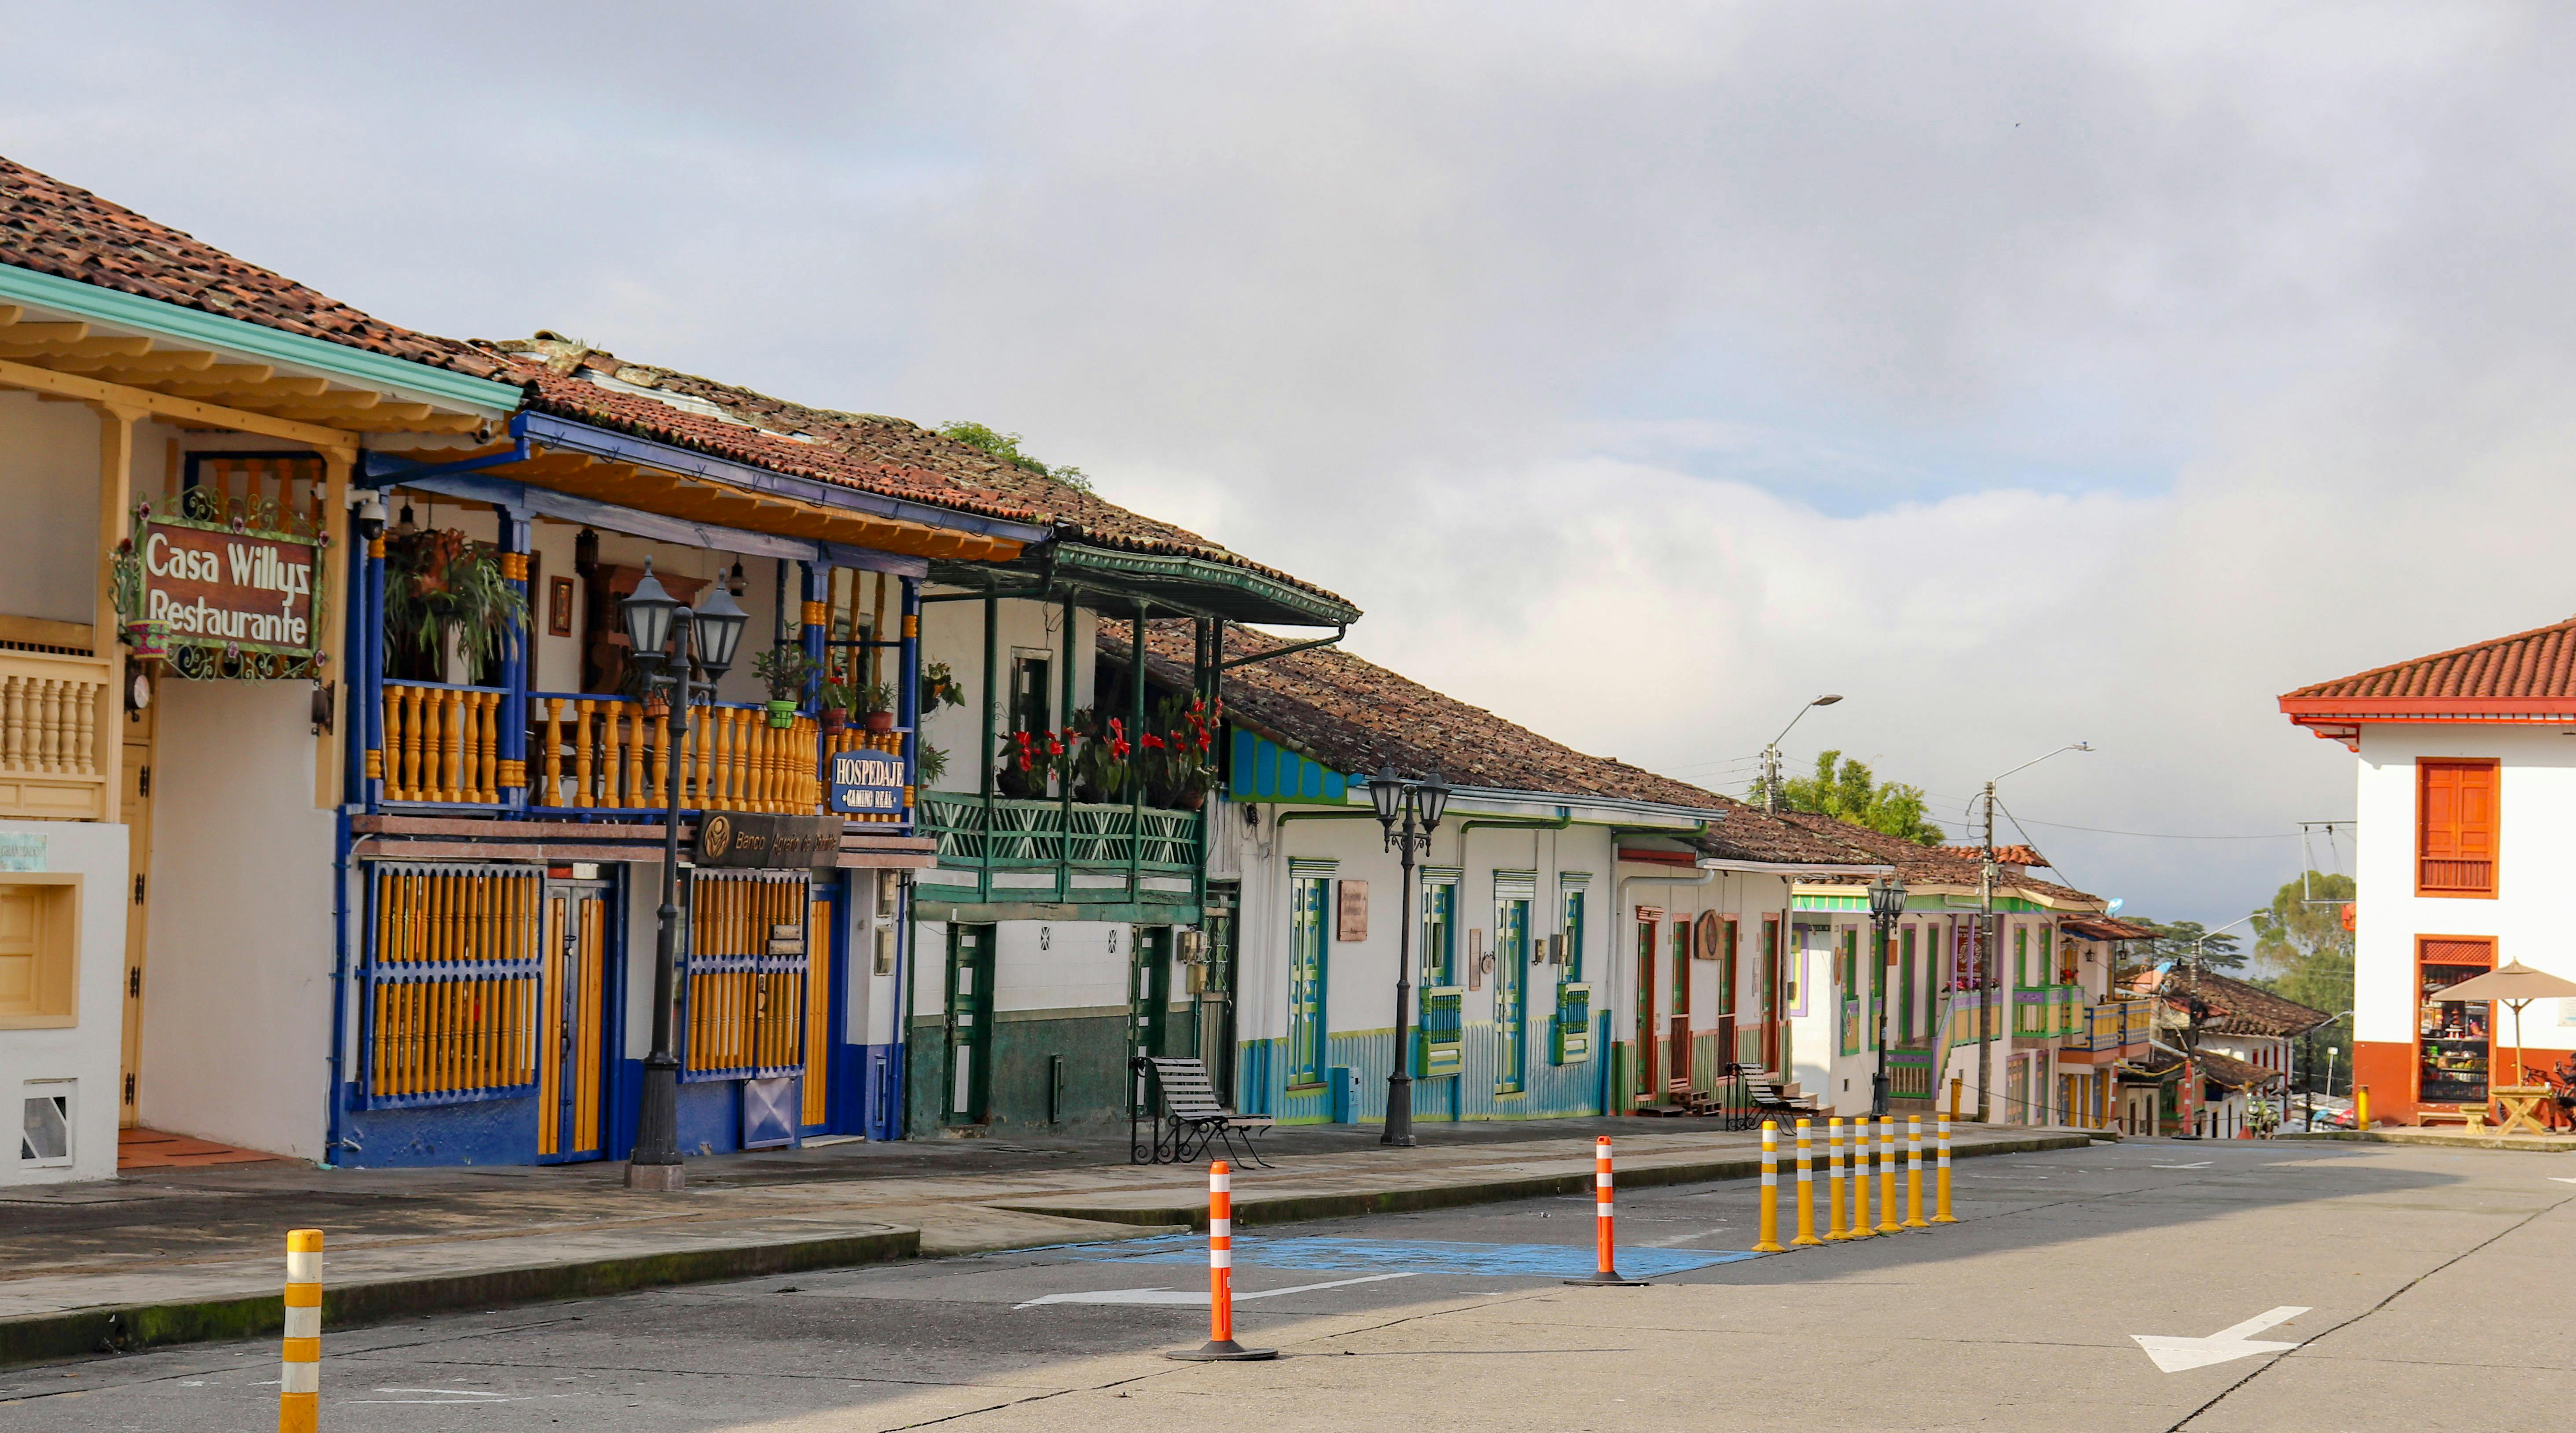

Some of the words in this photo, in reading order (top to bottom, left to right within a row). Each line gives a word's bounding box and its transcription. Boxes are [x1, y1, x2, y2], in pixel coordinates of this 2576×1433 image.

[146, 532, 219, 583] Casa
[227, 542, 311, 607] Willys
[150, 589, 307, 645] Restaurante
[835, 758, 904, 787] HOSPEDAJE
[846, 789, 873, 807] CAMINO
[875, 791, 893, 808] REAL
[735, 831, 765, 850] Banco
[772, 833, 799, 855] Agrario
[801, 834, 811, 852] de
